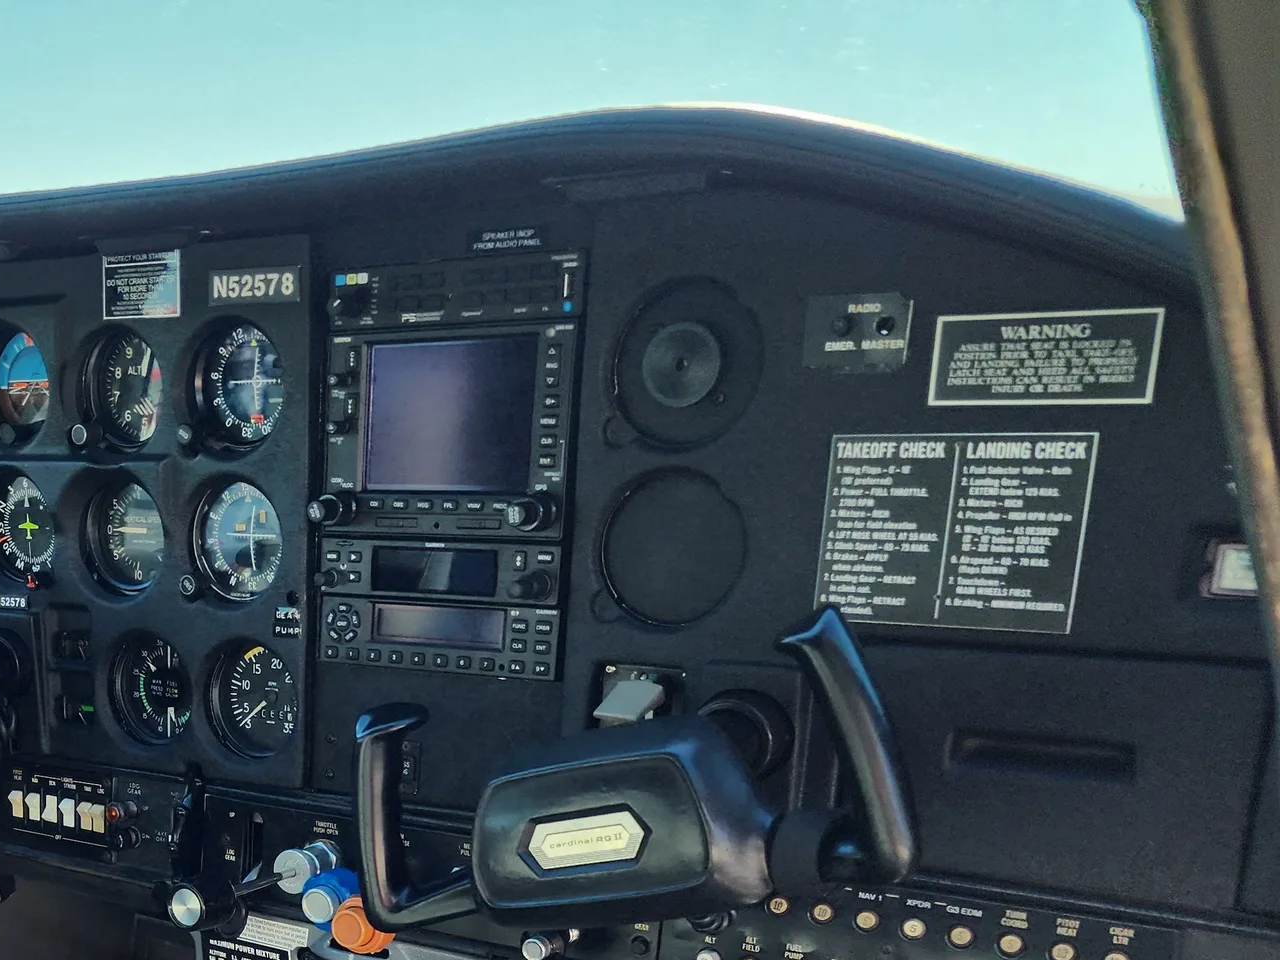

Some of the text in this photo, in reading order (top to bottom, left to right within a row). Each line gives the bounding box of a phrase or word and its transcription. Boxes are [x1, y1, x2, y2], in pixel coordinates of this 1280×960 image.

[482, 229, 535, 241] SPEAKER INOP
[473, 238, 542, 250] FROM AUDIO PANEL
[107, 255, 131, 263] PROTECT
[132, 253, 148, 261] YOUR
[129, 277, 148, 285] CRANK
[212, 272, 295, 299] N52578
[117, 286, 130, 294] FOR
[131, 285, 147, 293] MORE
[848, 303, 881, 313] RADIO
[232, 328, 245, 342] 12
[1001, 323, 1092, 340] WARNING
[825, 339, 906, 351] EMER. MASTER
[125, 346, 133, 359] 9
[115, 366, 122, 379] 8
[128, 366, 141, 377] ALT
[211, 372, 220, 380] 6
[114, 391, 120, 404] 7
[125, 410, 132, 423] 6
[241, 426, 254, 439] 33
[837, 442, 946, 459] TAKEOFF CHECK
[966, 442, 1087, 460] LANDING CHECK
[22, 478, 29, 488] 6
[221, 490, 232, 503] 12
[112, 498, 120, 510] 5
[107, 524, 114, 535] 0
[113, 550, 120, 561] 5
[134, 570, 143, 581] 10
[253, 662, 262, 675] 15
[270, 657, 283, 671] 20
[241, 678, 251, 691] 10
[242, 701, 251, 714] 5
[315, 820, 338, 830] THROTTLE
[312, 827, 340, 836] PUSH OPEN
[549, 832, 624, 850] cardinal RG II
[223, 855, 237, 863] GEAR
[858, 891, 877, 902] NAV
[772, 900, 784, 912] 10
[905, 898, 932, 909] XPDR
[960, 907, 984, 918] EDM
[704, 935, 717, 945] ALT
[744, 935, 758, 945] ALT
[209, 939, 281, 960] MAXIMUM POWER MIXTURE
[741, 942, 761, 953] FIELD
[785, 942, 804, 953] FUEL
[783, 949, 804, 960] PUMP
